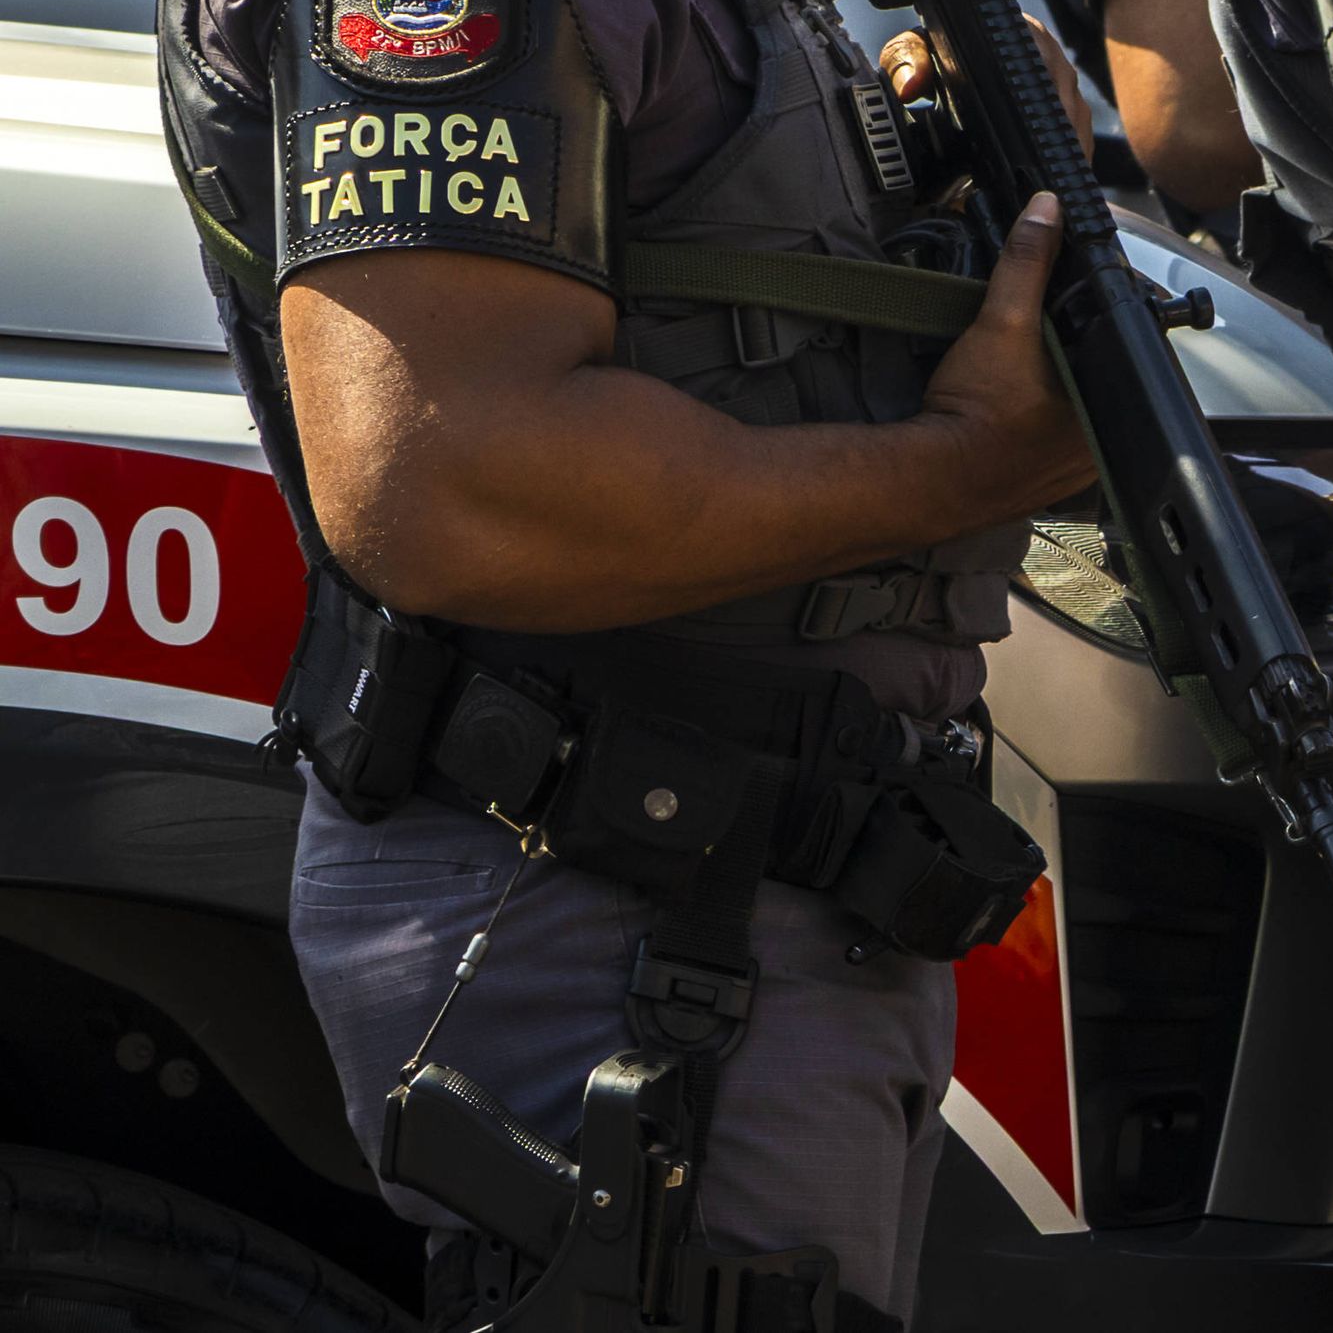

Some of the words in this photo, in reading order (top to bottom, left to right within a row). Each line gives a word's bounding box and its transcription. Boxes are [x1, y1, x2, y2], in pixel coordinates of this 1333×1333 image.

[313, 112, 520, 172] FORÇA
[301, 168, 530, 227] TATICA
[12, 496, 220, 646] 90
